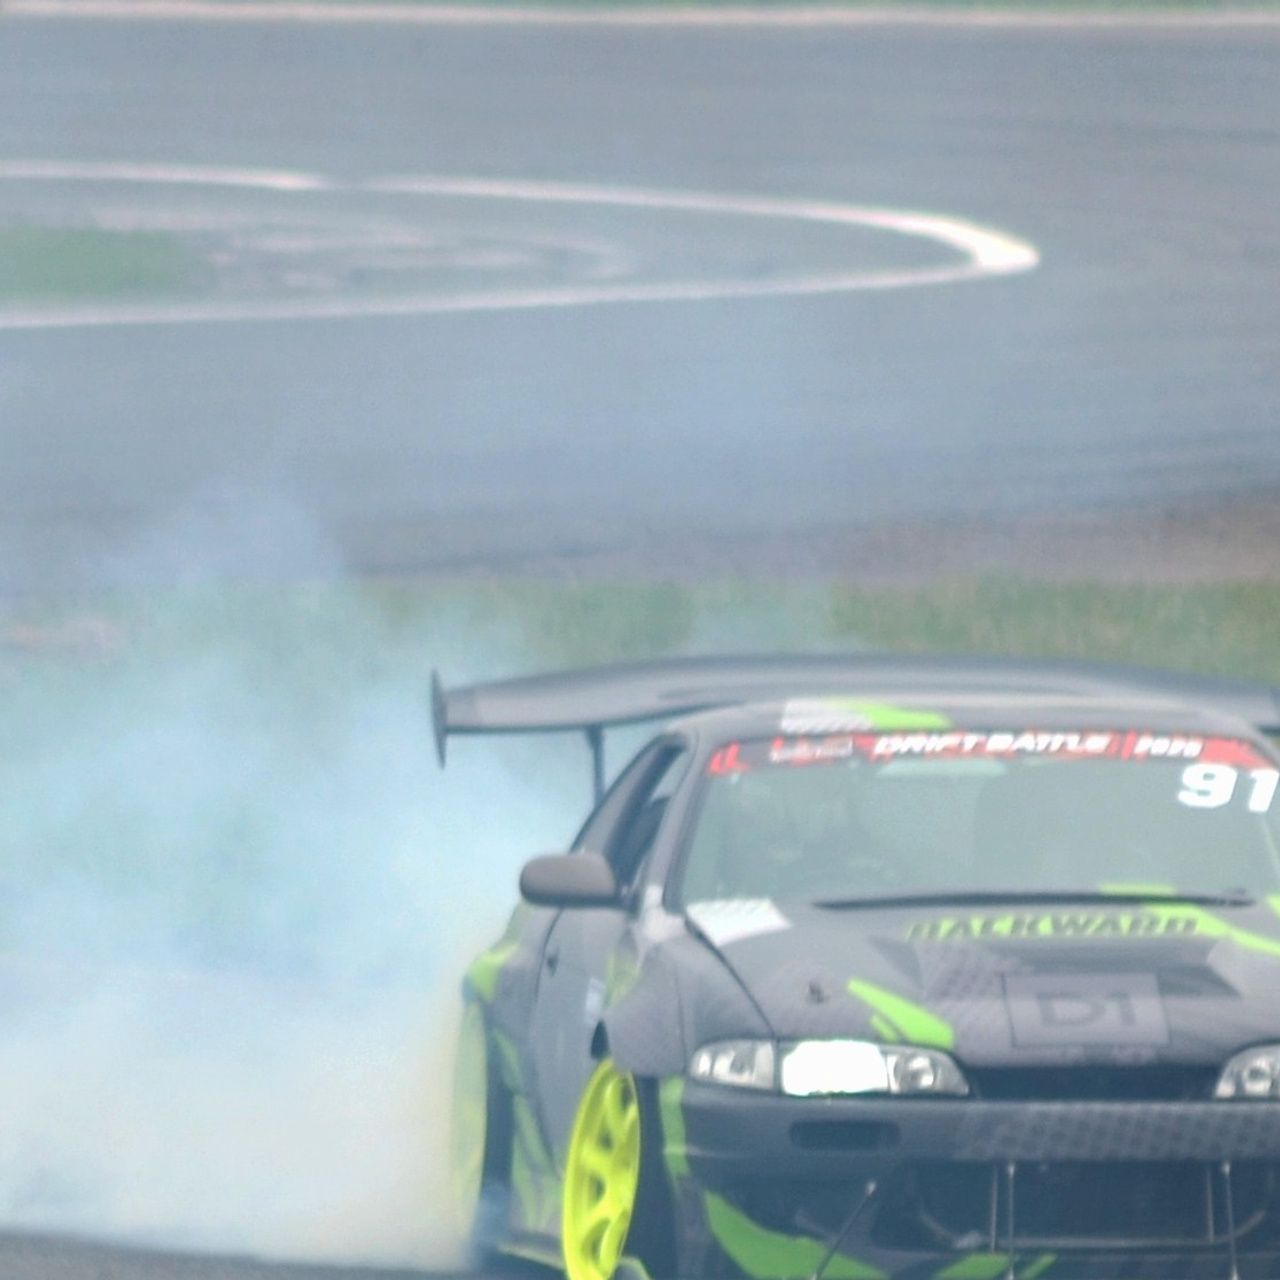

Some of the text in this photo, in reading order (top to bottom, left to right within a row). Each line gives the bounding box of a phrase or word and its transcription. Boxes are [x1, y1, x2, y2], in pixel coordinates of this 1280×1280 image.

[873, 733, 989, 754] DRIFT
[983, 732, 1113, 754] BATTLE
[1177, 762, 1280, 813] 91
[904, 913, 1203, 941] BACKWARD
